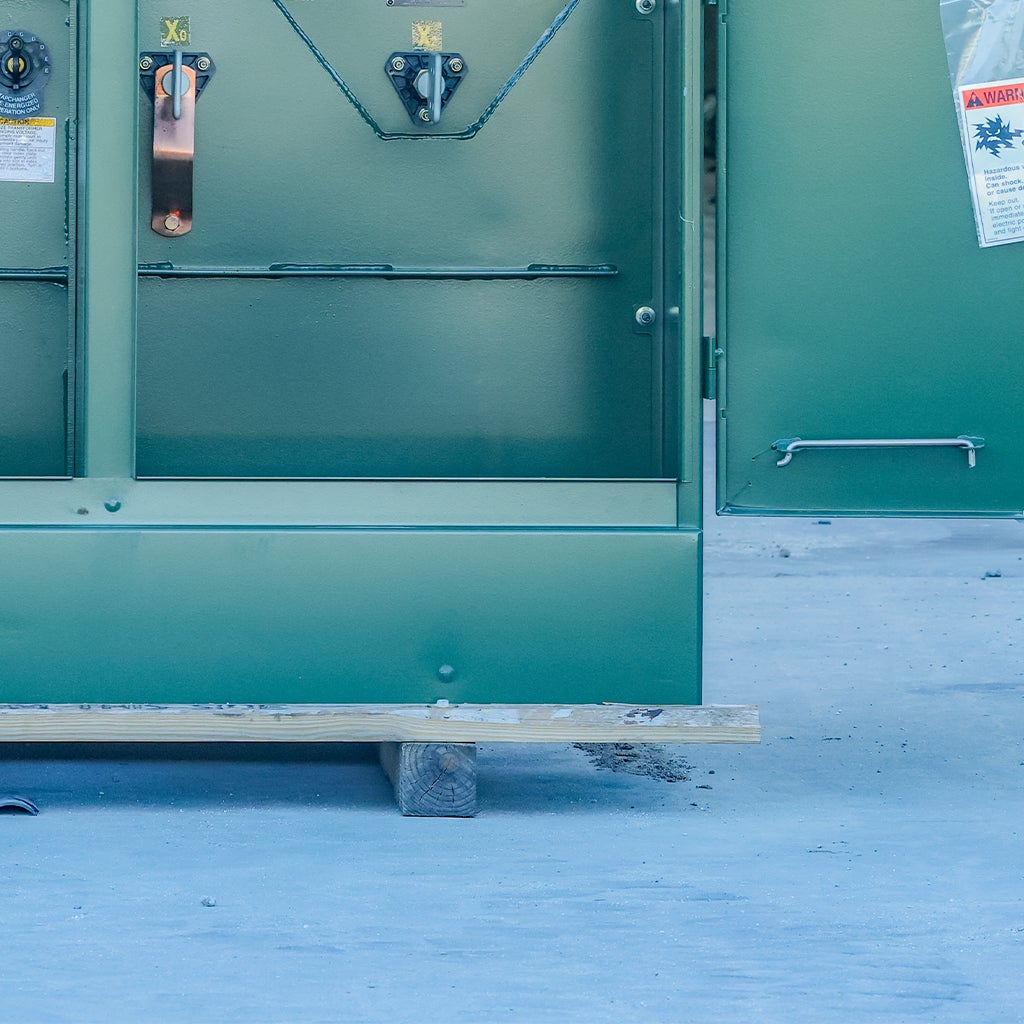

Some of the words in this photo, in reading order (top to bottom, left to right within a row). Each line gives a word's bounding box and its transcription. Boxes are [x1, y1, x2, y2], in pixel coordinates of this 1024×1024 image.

[165, 19, 187, 42] X0
[26, 103, 41, 113] ONLY
[983, 165, 1020, 175] Hazardous
[996, 187, 1017, 195] cause
